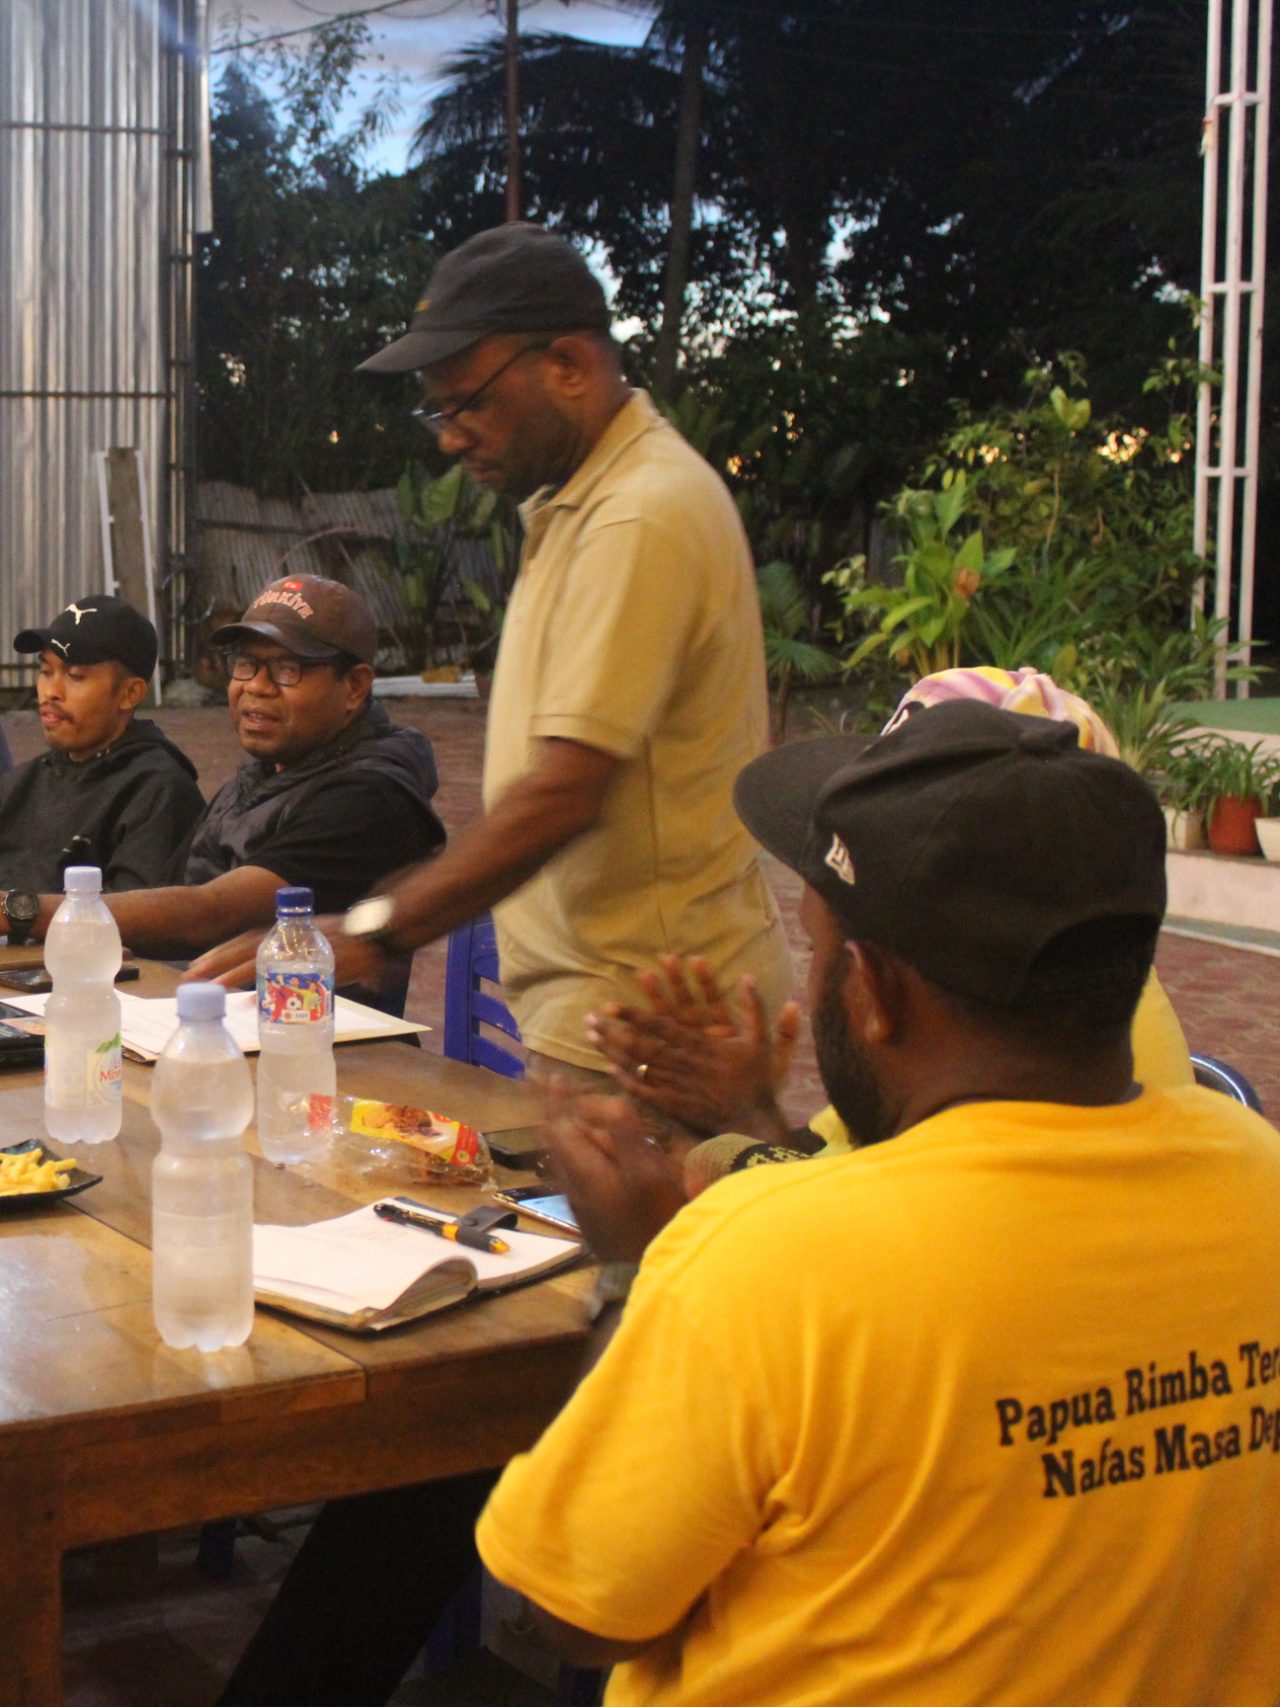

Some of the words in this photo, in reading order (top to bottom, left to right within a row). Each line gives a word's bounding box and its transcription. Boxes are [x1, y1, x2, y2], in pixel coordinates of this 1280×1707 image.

[996, 1386, 1116, 1447] Papua
[1125, 1350, 1232, 1417] Rimba
[1238, 1342, 1280, 1389] Ter
[1041, 1438, 1145, 1498] Nafas
[1154, 1423, 1241, 1475] Masa
